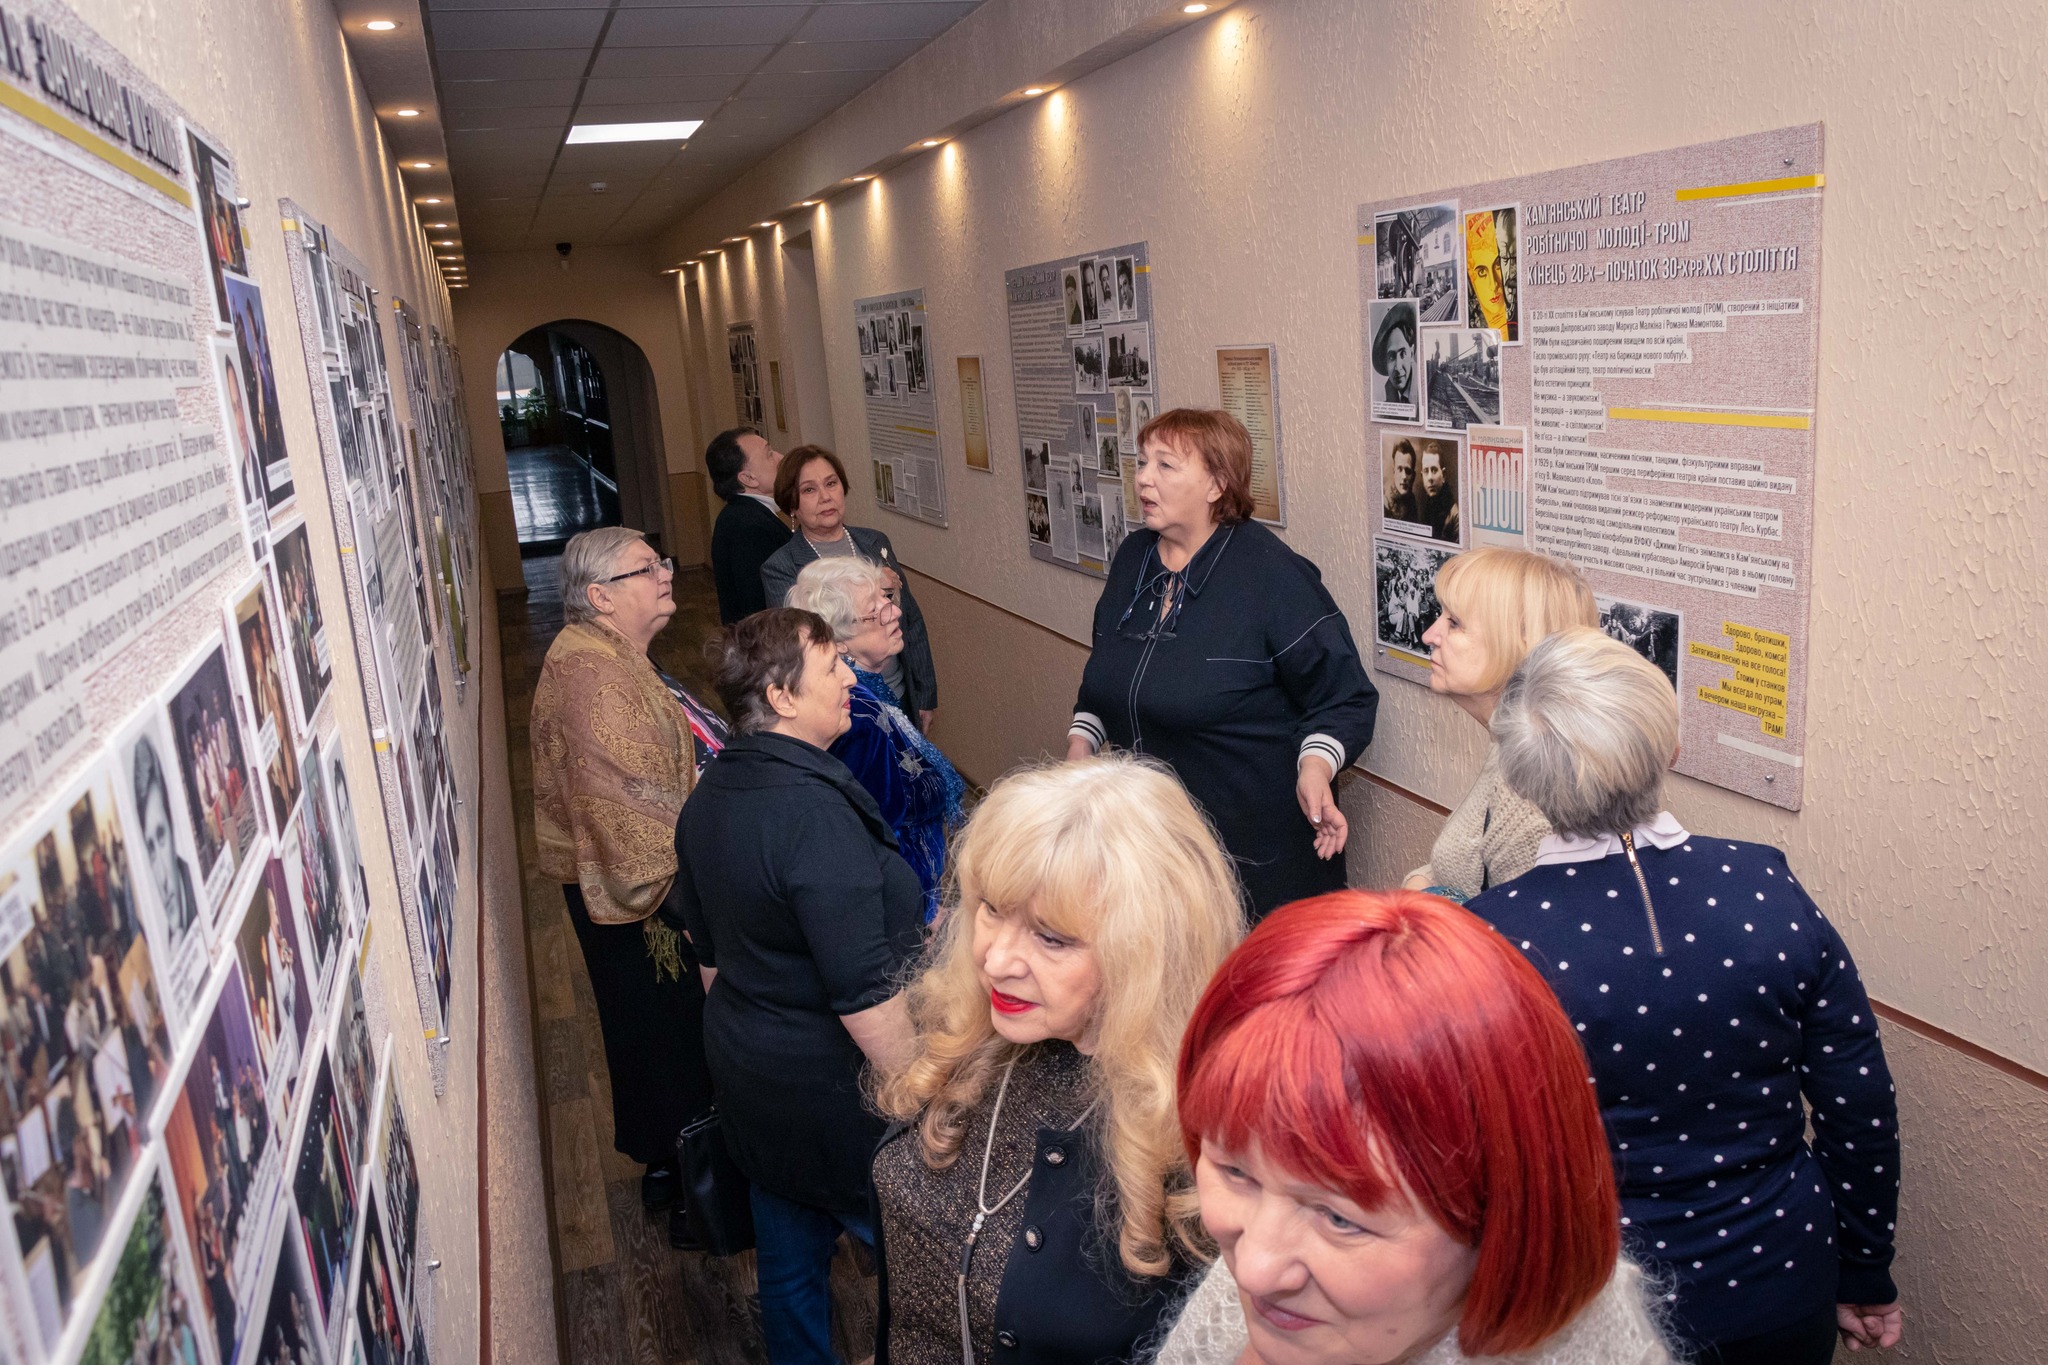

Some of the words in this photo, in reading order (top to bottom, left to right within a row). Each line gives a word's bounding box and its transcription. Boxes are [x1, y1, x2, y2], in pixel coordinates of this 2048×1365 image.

[1525, 193, 1602, 226] КАМ'ЯНСЬКИЙ
[1608, 191, 1646, 216] ТЕАТР
[1654, 220, 1690, 244] ТРОМ
[1528, 262, 1567, 286] КІНЕЦЬ
[1728, 246, 1798, 274] СТОЛІТТЯ
[1645, 337, 1654, 345] по
[1472, 449, 1523, 531] КЛОП
[1746, 478, 1769, 489] щойно
[1768, 481, 1793, 494] видану
[1739, 521, 1756, 534] Лесь
[1746, 570, 1767, 583] ньому
[1780, 561, 1790, 570] на
[1724, 623, 1753, 641] Здорово,
[1753, 631, 1788, 650] братишки,
[1690, 643, 1721, 660] Затягивай
[1720, 653, 1741, 666] песню
[1741, 658, 1750, 668] на
[1750, 661, 1762, 672] все
[1761, 664, 1786, 678] голоса!
[1735, 640, 1764, 658] Здорово,
[1764, 651, 1787, 663] комса!
[1735, 670, 1755, 684] Стоим
[1755, 678, 1760, 688] у
[1760, 680, 1786, 693] станков
[1698, 688, 1704, 697] А
[1703, 691, 1730, 708] вечером
[1729, 699, 1747, 711] наша
[1747, 704, 1776, 720] нагрузка
[1721, 680, 1732, 692] Мы
[1732, 685, 1754, 699] всегда
[1754, 691, 1763, 701] по
[1763, 694, 1785, 709] утрам,
[1764, 721, 1783, 736] ТРАМ!
